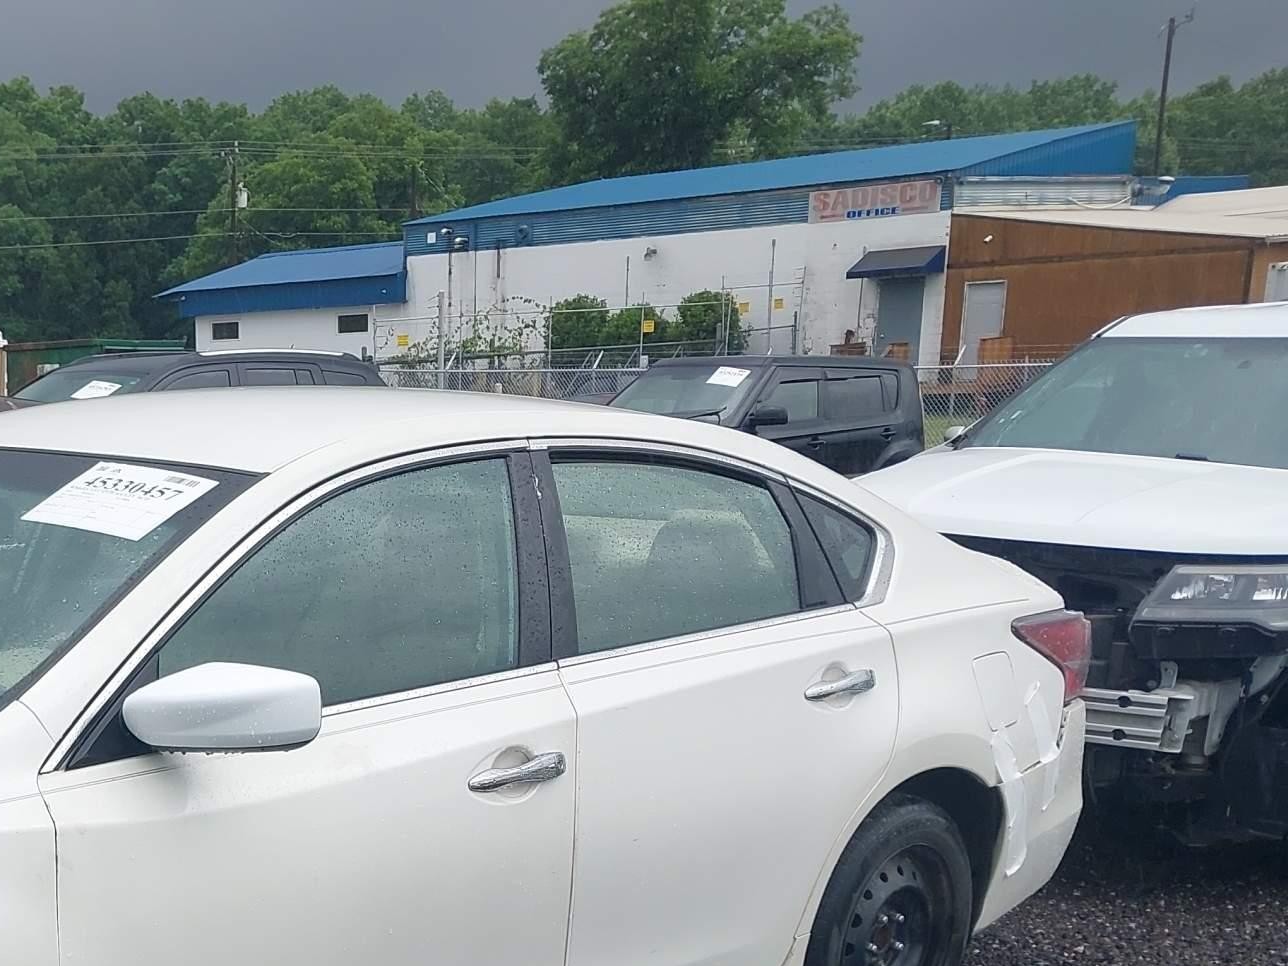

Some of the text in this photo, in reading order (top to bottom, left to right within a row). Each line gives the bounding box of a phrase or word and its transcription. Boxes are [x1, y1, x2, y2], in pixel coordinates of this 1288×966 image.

[814, 182, 937, 211] SADISCO
[846, 206, 901, 220] OFFICE
[83, 475, 185, 501] 45330457
